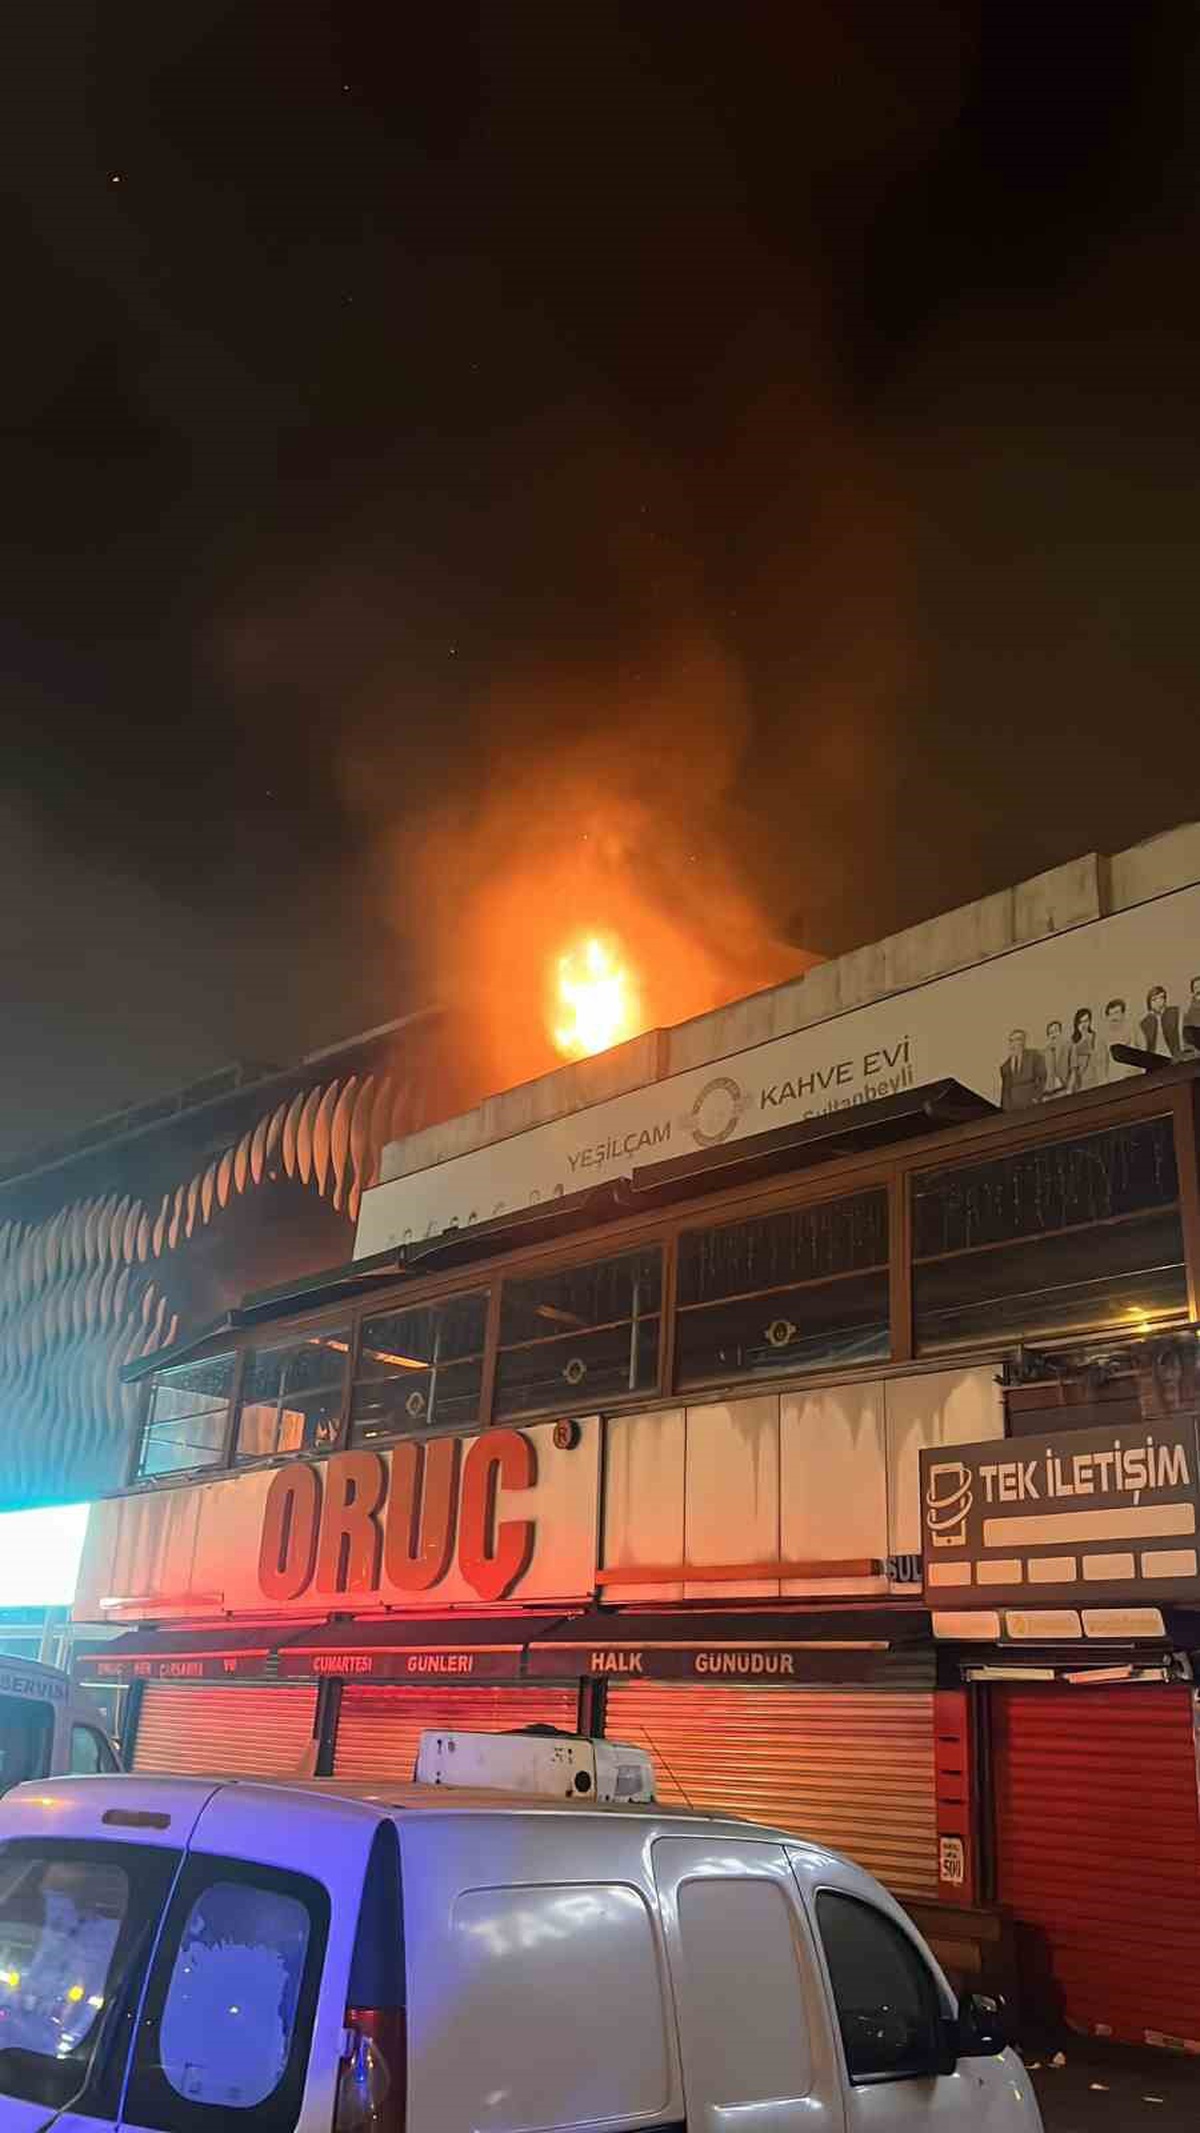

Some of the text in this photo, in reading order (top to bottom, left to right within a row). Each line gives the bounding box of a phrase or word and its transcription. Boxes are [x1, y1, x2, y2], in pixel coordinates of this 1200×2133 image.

[760, 1061, 854, 1110] KAHVE
[863, 1034, 910, 1077] EVİ
[978, 1436, 1191, 1506] TEK İLETİŞİM
[257, 1428, 538, 1601] ORUÇ
[591, 1652, 644, 1673] HALK
